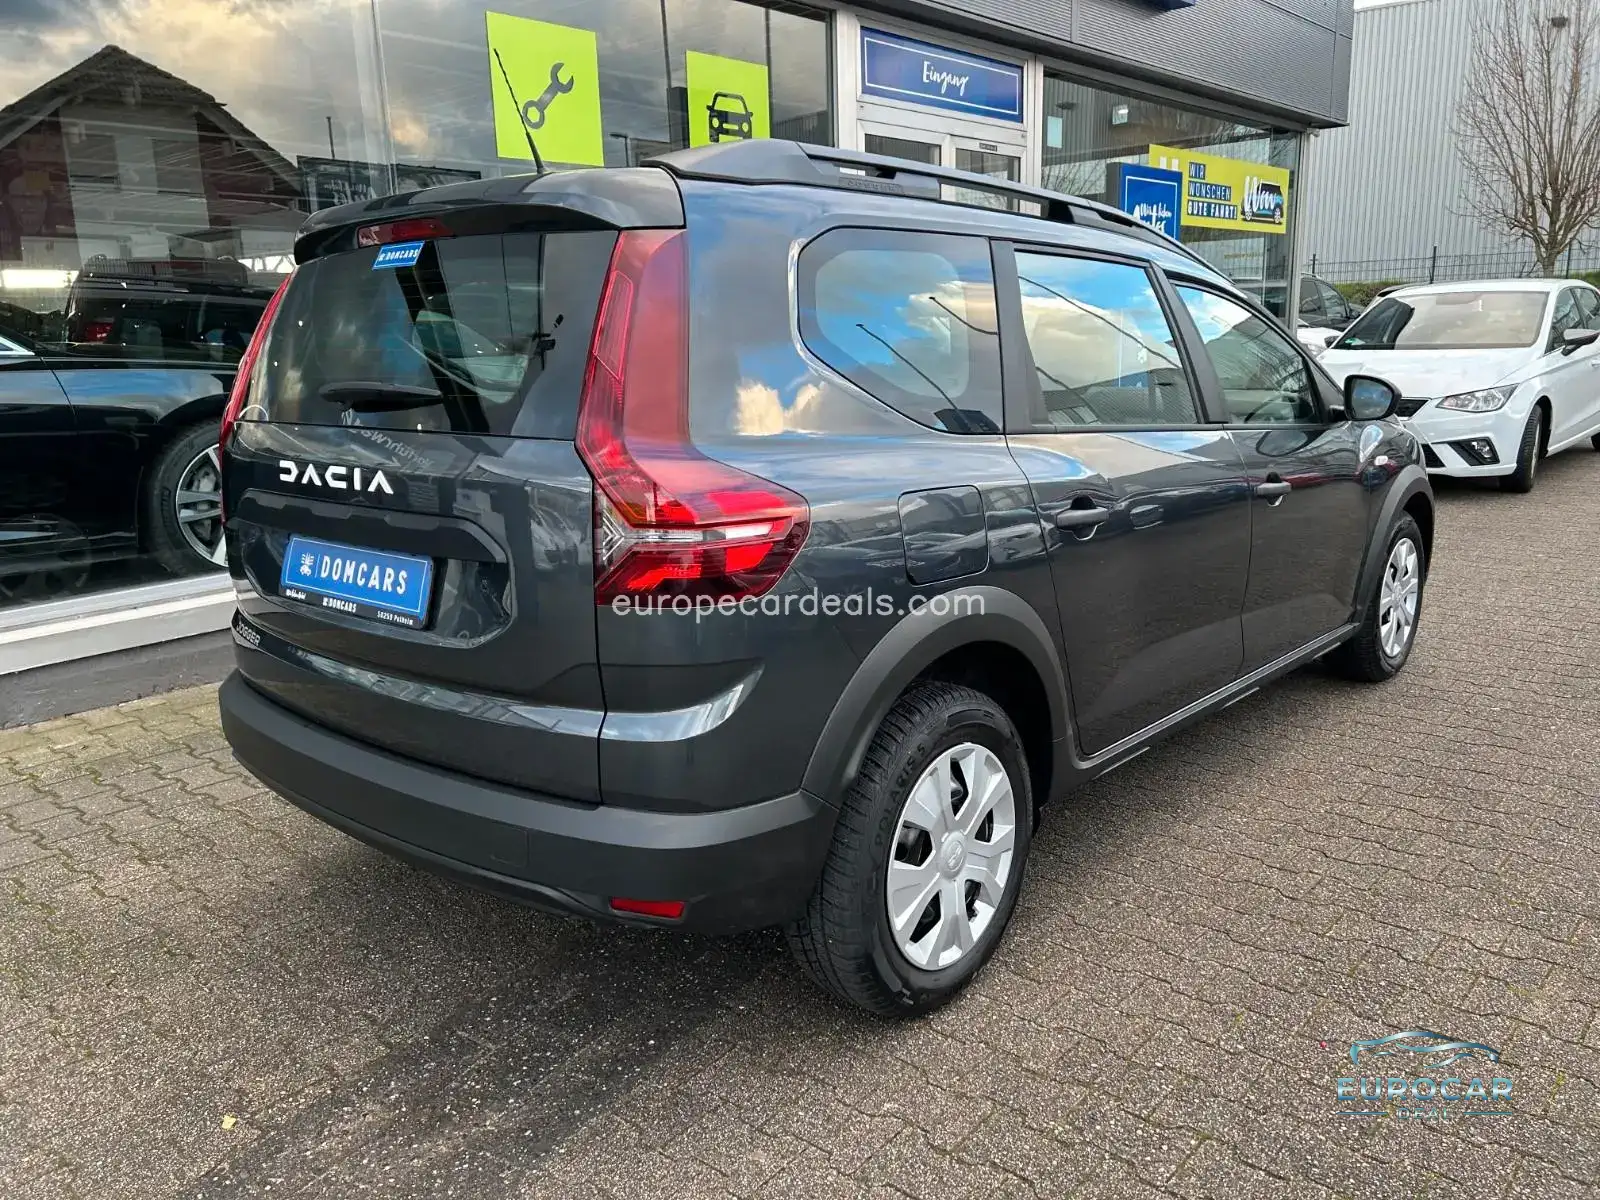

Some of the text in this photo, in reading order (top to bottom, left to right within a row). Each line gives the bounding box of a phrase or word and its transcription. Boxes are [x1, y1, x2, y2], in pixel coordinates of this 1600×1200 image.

[922, 60, 970, 97] Eingang
[1189, 163, 1205, 179] WIR
[1187, 200, 1238, 219] GUTE FAHRT!
[279, 459, 395, 496] DACIA
[320, 555, 408, 595] DOMCARS
